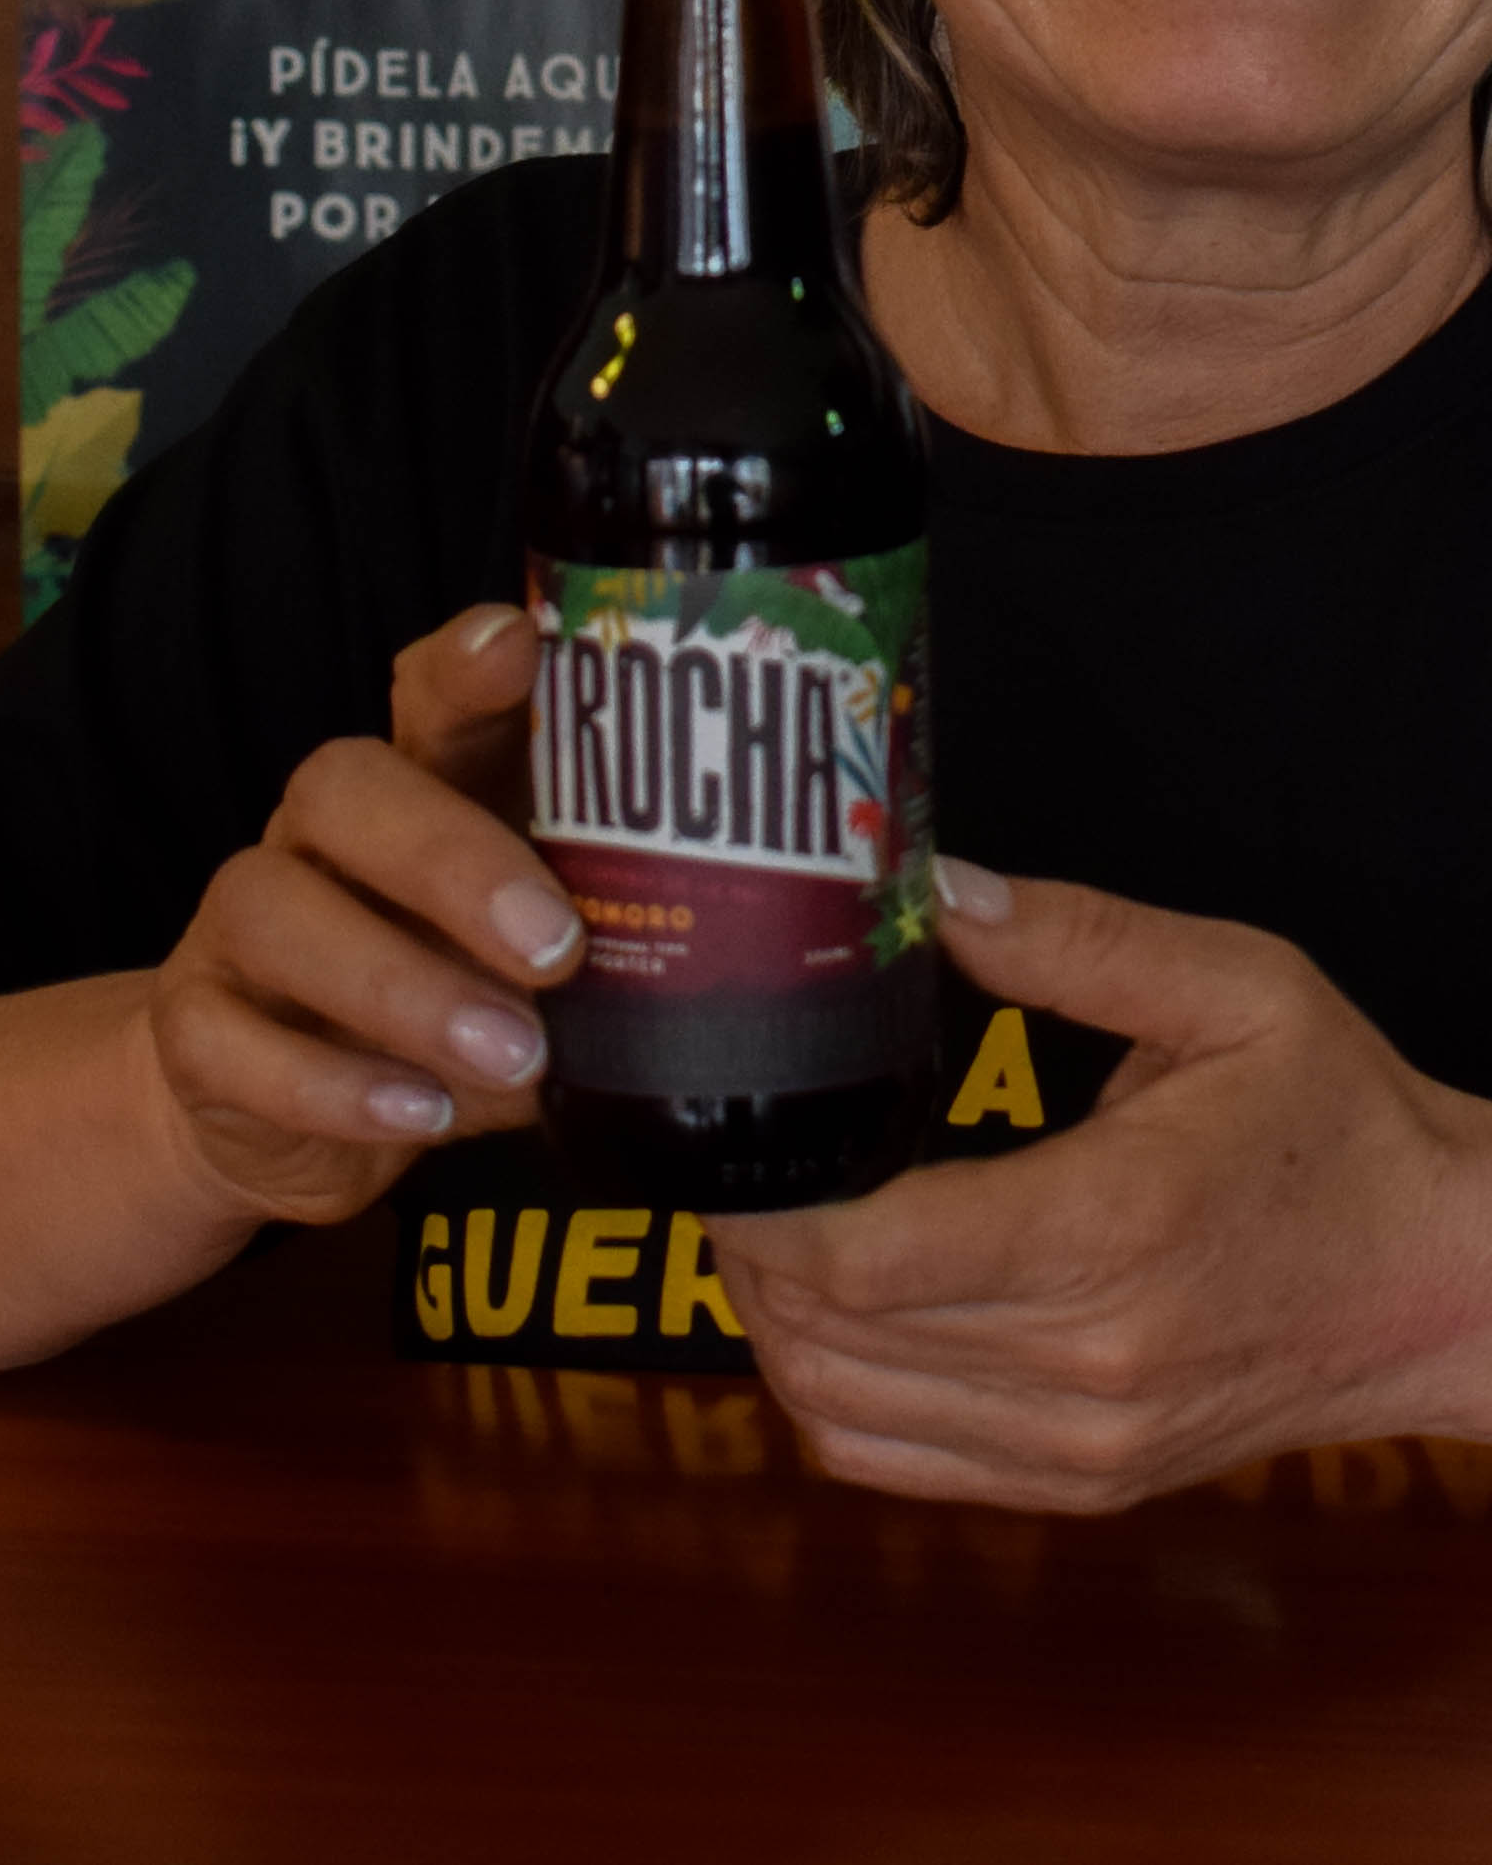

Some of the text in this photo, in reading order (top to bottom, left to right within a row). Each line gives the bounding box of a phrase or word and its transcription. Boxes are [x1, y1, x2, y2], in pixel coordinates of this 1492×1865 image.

[268, 36, 621, 102] PÍDELA AQU
[229, 117, 612, 171] ¡Y BRINDEM
[268, 190, 401, 243] POR
[415, 1207, 747, 1343] GUER
